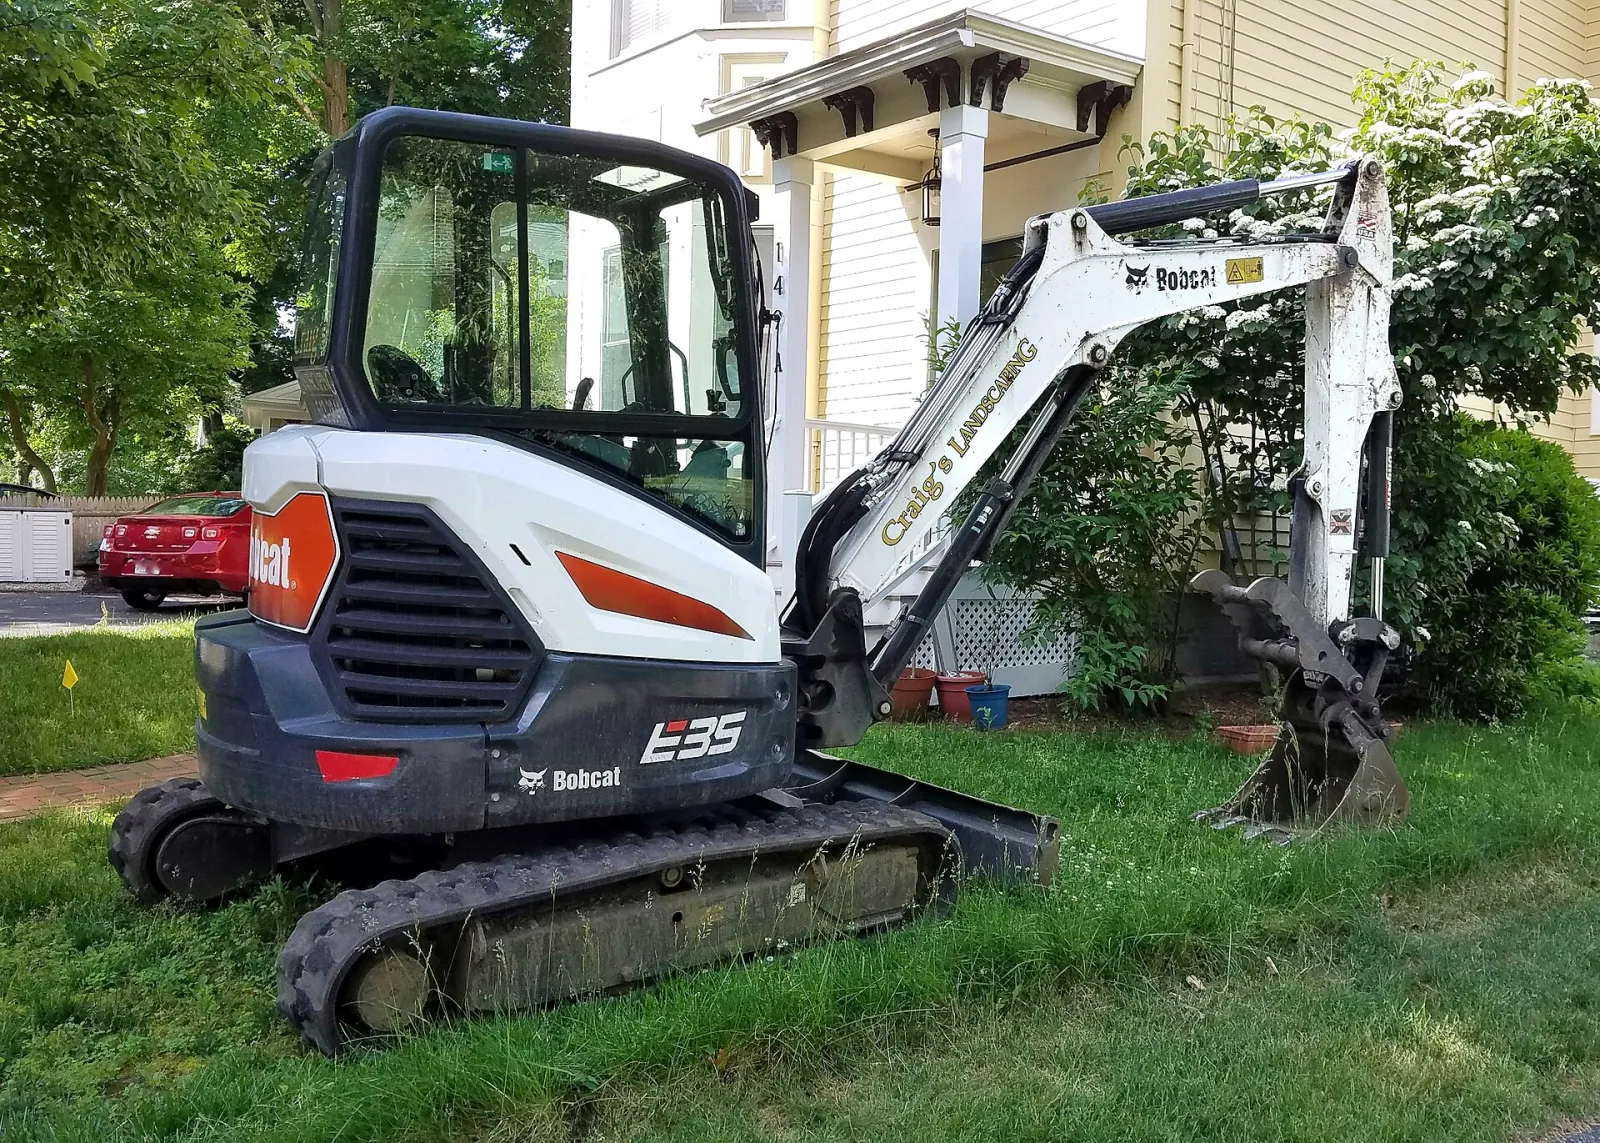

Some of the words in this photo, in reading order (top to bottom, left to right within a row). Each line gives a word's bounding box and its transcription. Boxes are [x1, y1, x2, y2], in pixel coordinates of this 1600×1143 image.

[881, 455, 953, 547] Craig's
[947, 337, 1038, 458] LANDSCAPING
[639, 711, 747, 764] E35
[553, 766, 621, 792] Bobcat
